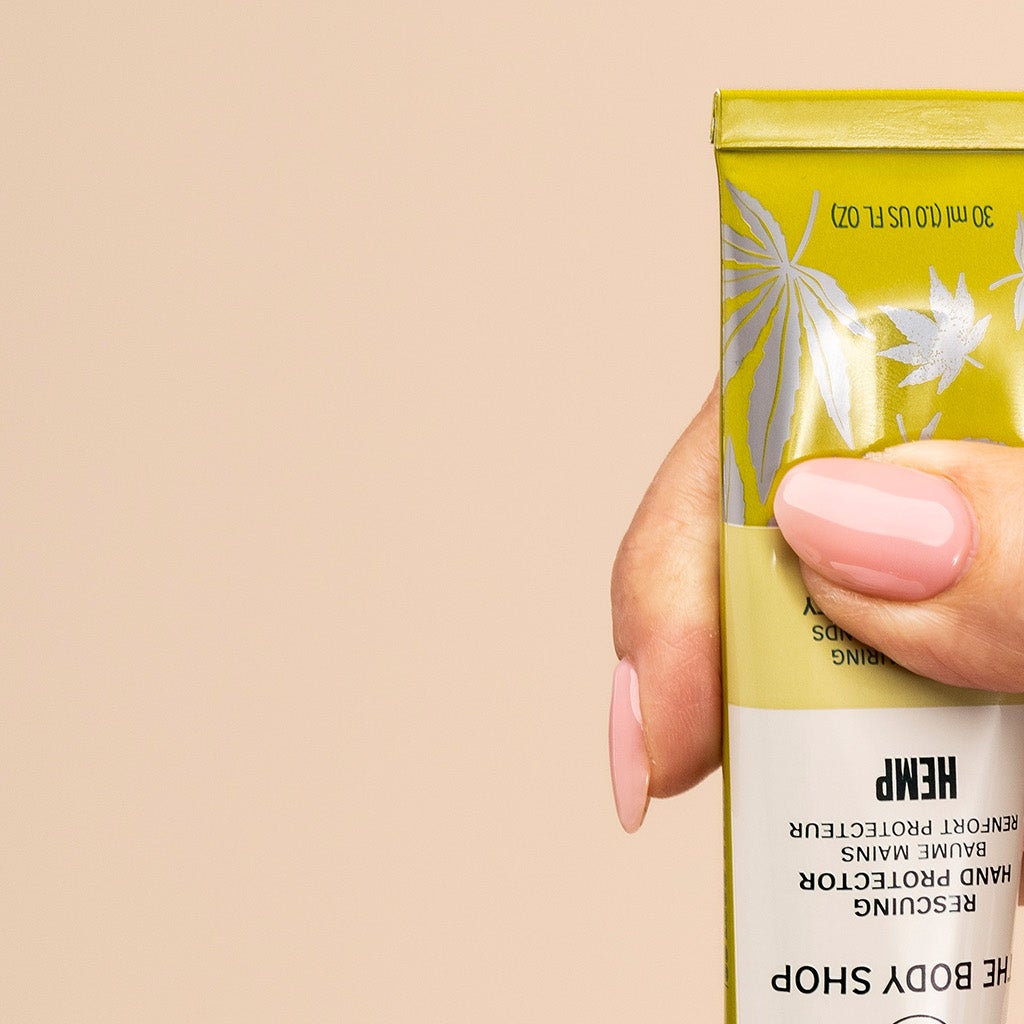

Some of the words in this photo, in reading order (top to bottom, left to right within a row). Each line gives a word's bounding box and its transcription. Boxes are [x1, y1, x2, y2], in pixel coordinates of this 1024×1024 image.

[831, 203, 860, 228] OZ)
[863, 205, 884, 228] FL
[888, 205, 911, 228] US
[915, 203, 942, 228] (1.0
[946, 205, 968, 228] ml
[972, 205, 994, 228] 30
[831, 649, 896, 665] IRING
[876, 756, 957, 801] HEMP
[789, 820, 932, 838] PROTECTEUR
[940, 815, 1018, 835] RENFORT
[841, 845, 909, 862] MAINS
[918, 842, 986, 860] BAUME
[799, 870, 950, 890] PROTECTOR
[960, 864, 1011, 886] HAND
[854, 894, 976, 916] RESCUING
[771, 964, 871, 995] SHOP
[883, 962, 972, 994] BODY
